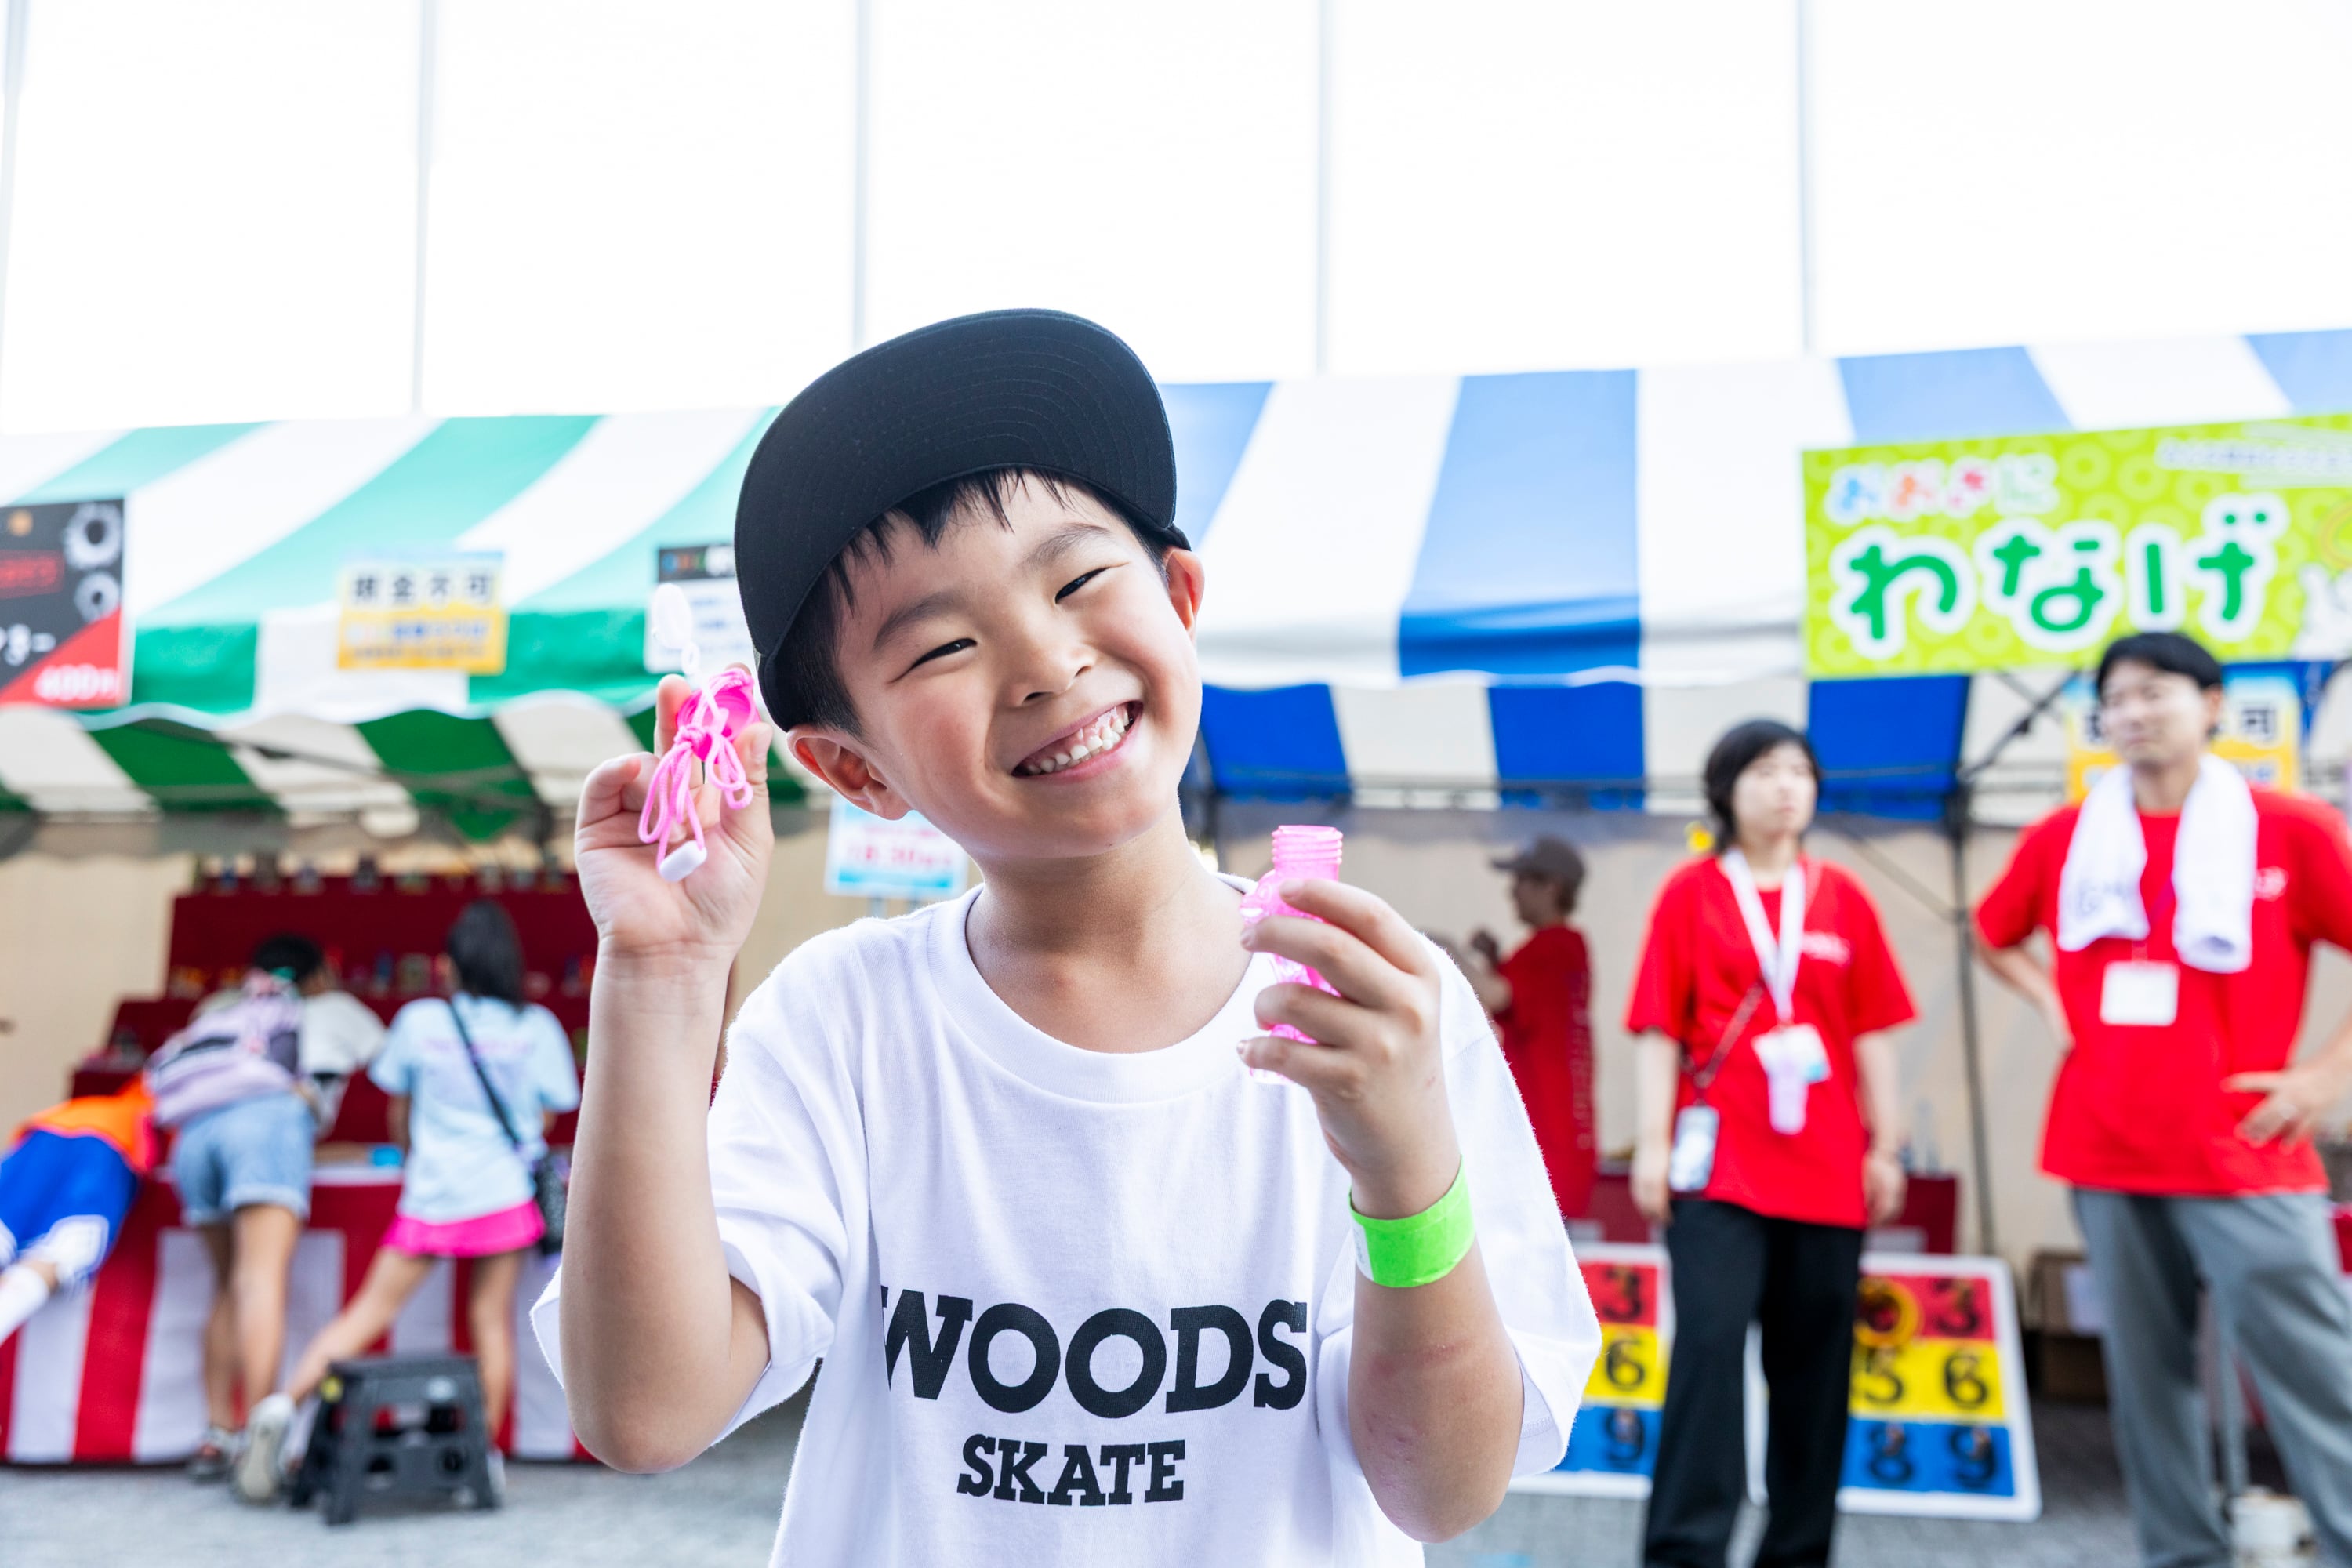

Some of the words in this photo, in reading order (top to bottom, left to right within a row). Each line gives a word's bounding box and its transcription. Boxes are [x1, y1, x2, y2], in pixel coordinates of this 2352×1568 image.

[1850, 512, 2267, 640] わなげ
[1602, 1265, 1642, 1323] 3
[1933, 1278, 1980, 1338] 3
[880, 1285, 1307, 1418] WOODS
[1606, 1338, 1645, 1392] 6
[1944, 1350, 1989, 1410] 6
[956, 1434, 1185, 1506] SKATE
[1949, 1422, 1997, 1490] 9
